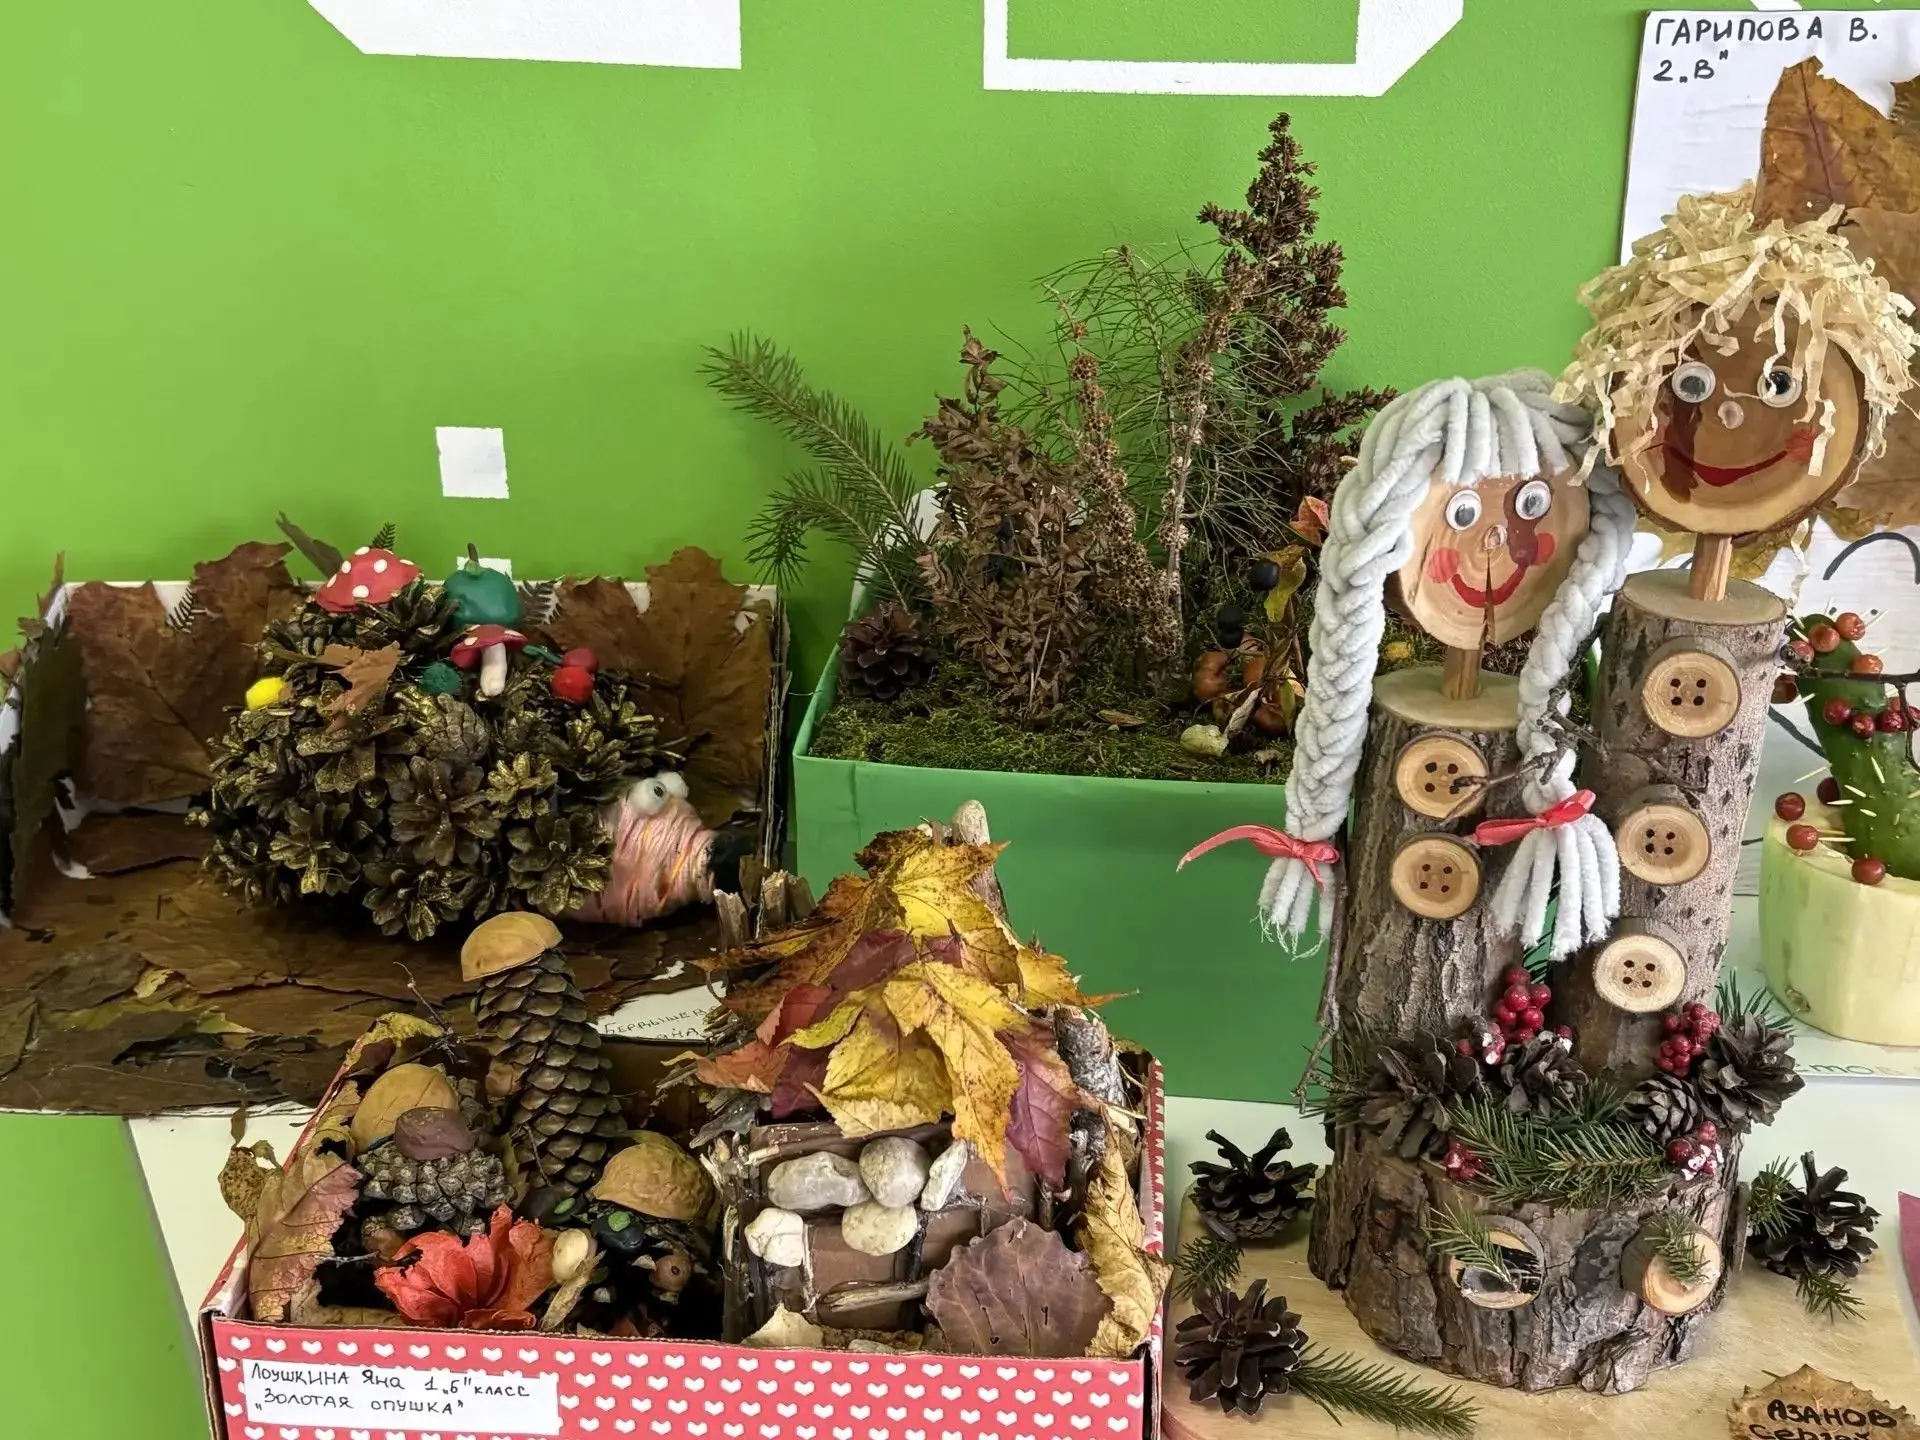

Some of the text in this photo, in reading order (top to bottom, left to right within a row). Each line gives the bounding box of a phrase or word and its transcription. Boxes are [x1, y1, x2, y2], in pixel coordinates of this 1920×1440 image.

[1655, 16, 1879, 47] ГАРИПОВА В.
[1766, 1399, 1898, 1428] АЗАНОВ
